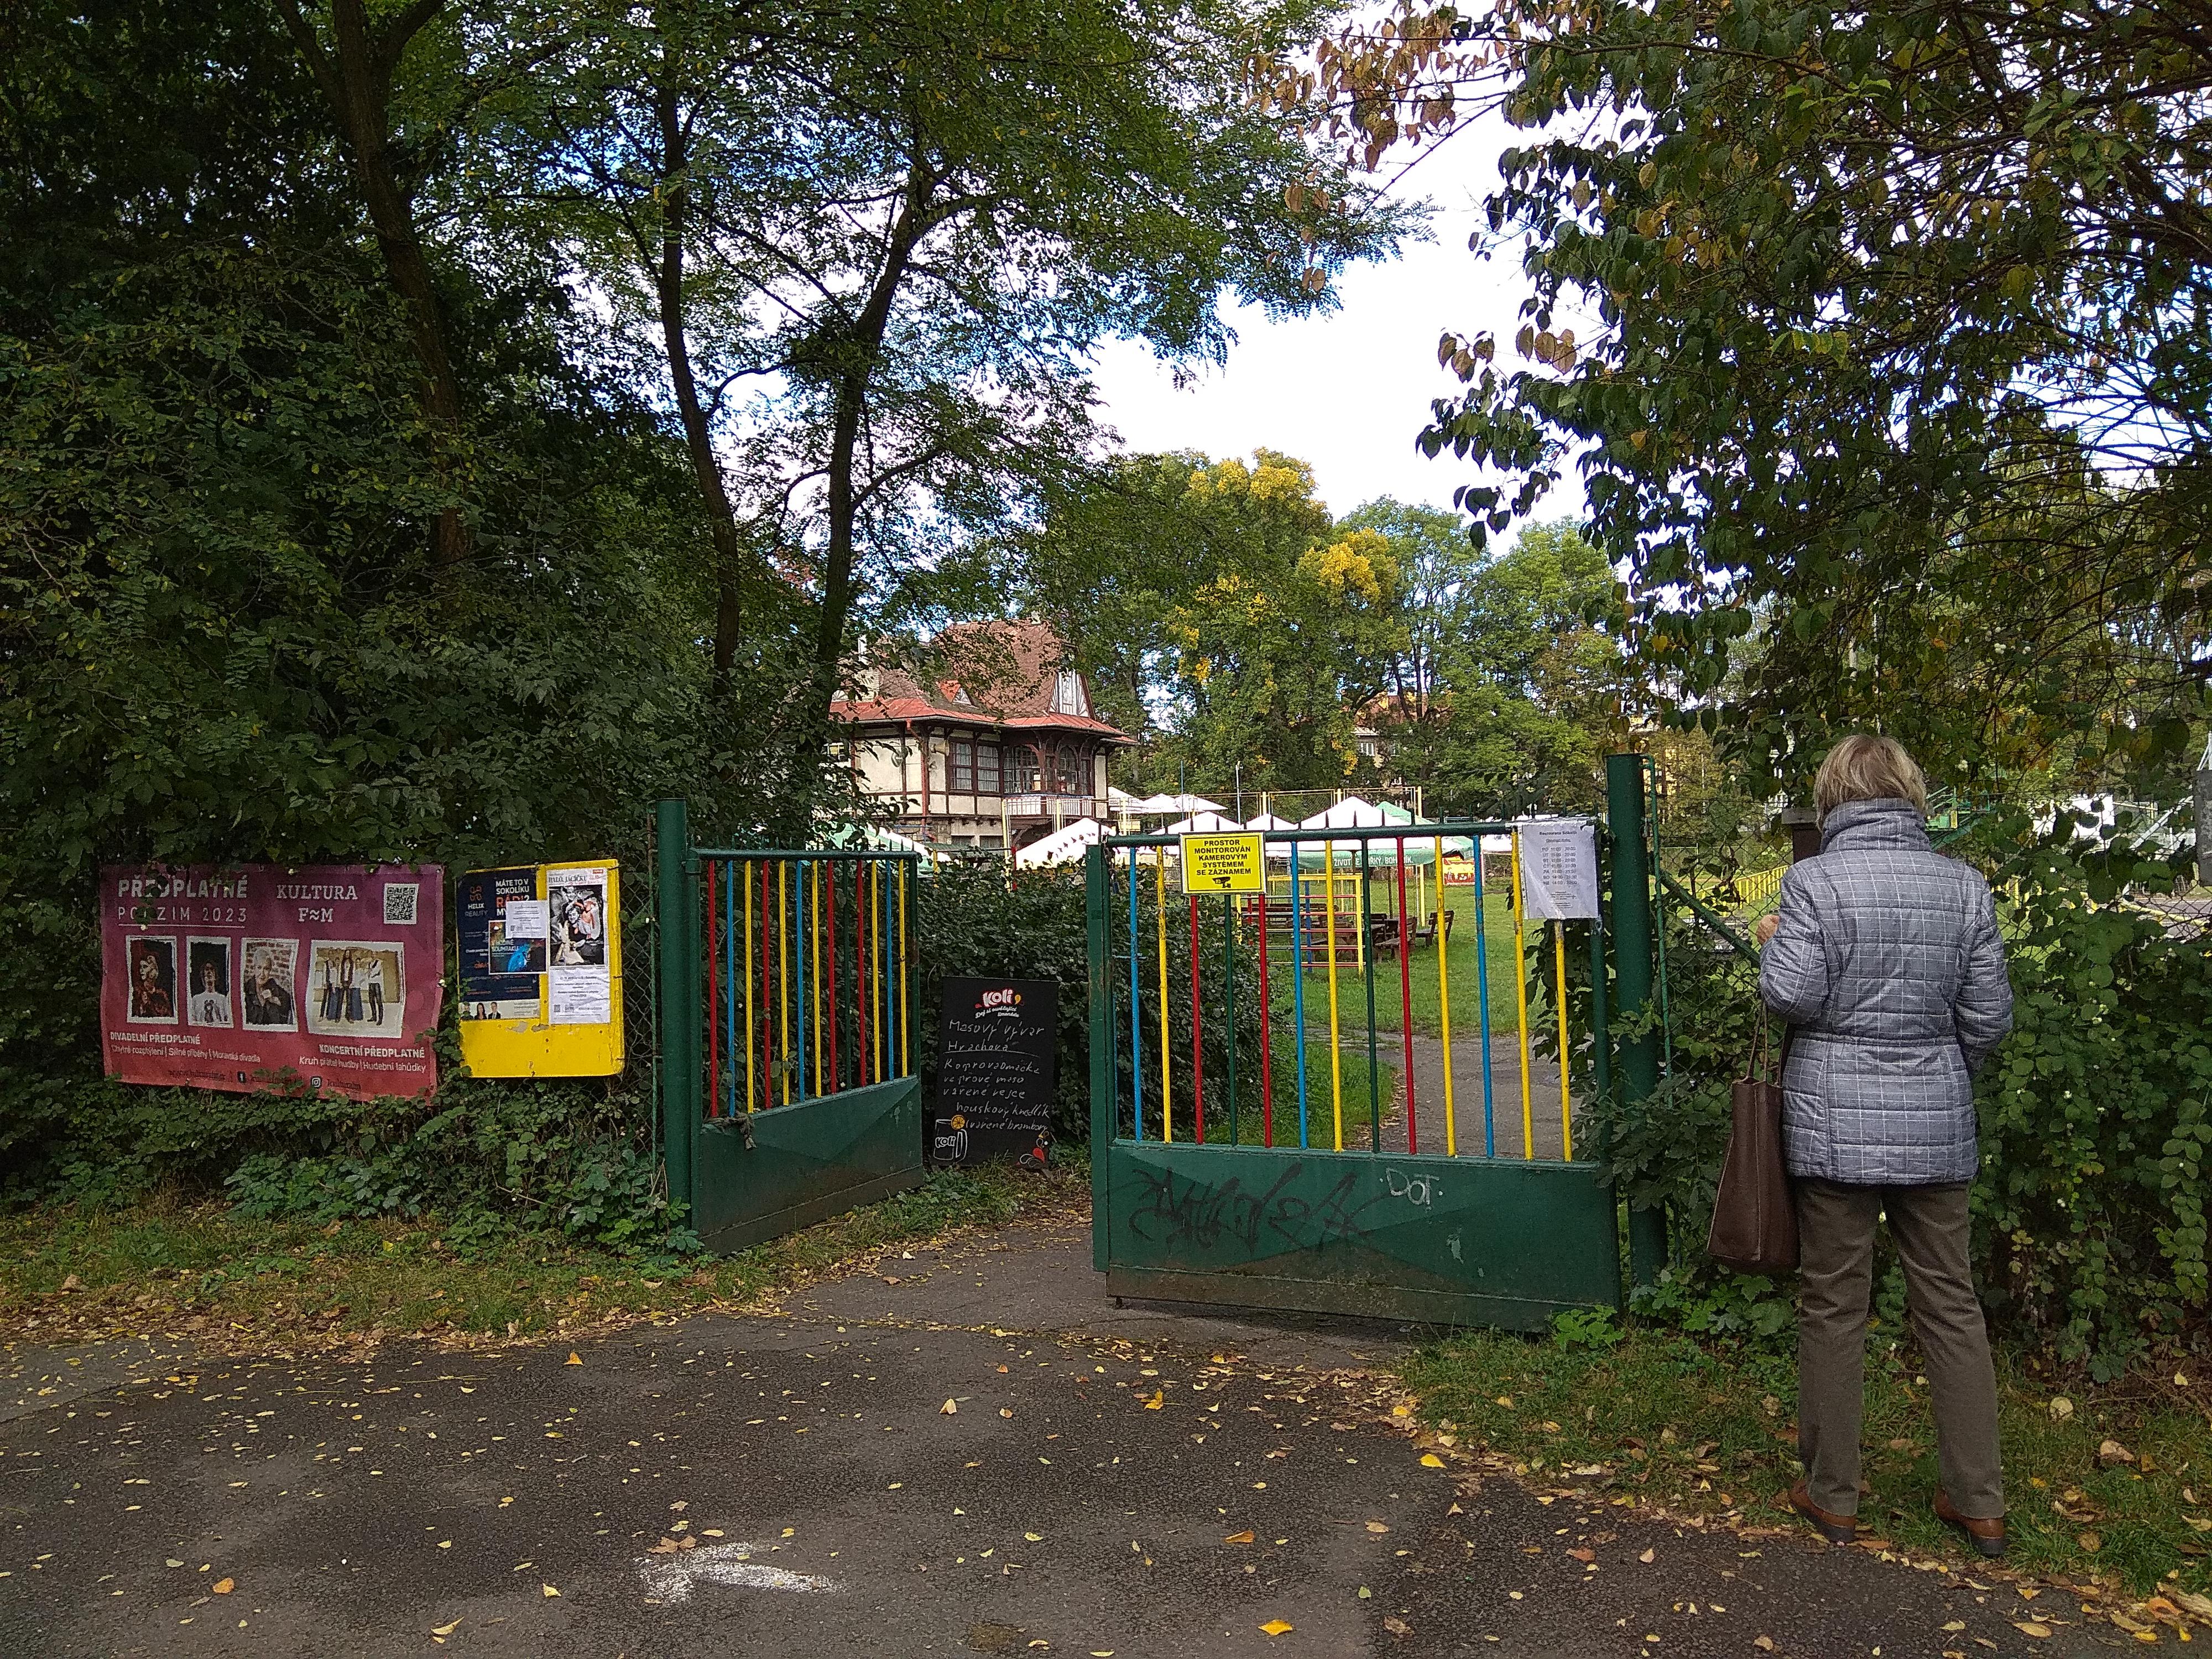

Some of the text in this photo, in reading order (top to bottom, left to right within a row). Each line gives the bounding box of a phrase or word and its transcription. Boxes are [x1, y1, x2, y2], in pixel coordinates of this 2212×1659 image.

[1194, 846, 1251, 854] MONITOROVÁN
[1334, 858, 1351, 867] ŽIVOT
[495, 879, 513, 887] MÁTE
[496, 885, 530, 895] SOKOLÍKU
[276, 885, 358, 900] KULTURA
[202, 907, 247, 922] 2023
[949, 1019, 1045, 1041] Masový vývar
[111, 1031, 201, 1045] DIVADELNÍ PŘEDPLATNÉ
[948, 1037, 1009, 1051] Hrachová
[319, 1044, 425, 1058] KONCERTNÍ PŘEDPLATNÉ
[299, 1055, 319, 1065] Kruh
[363, 1061, 394, 1071] Hudební
[395, 1061, 426, 1073] lahůdky
[993, 1089, 1025, 1099] vejce
[1012, 1103, 1050, 1119] knedlík
